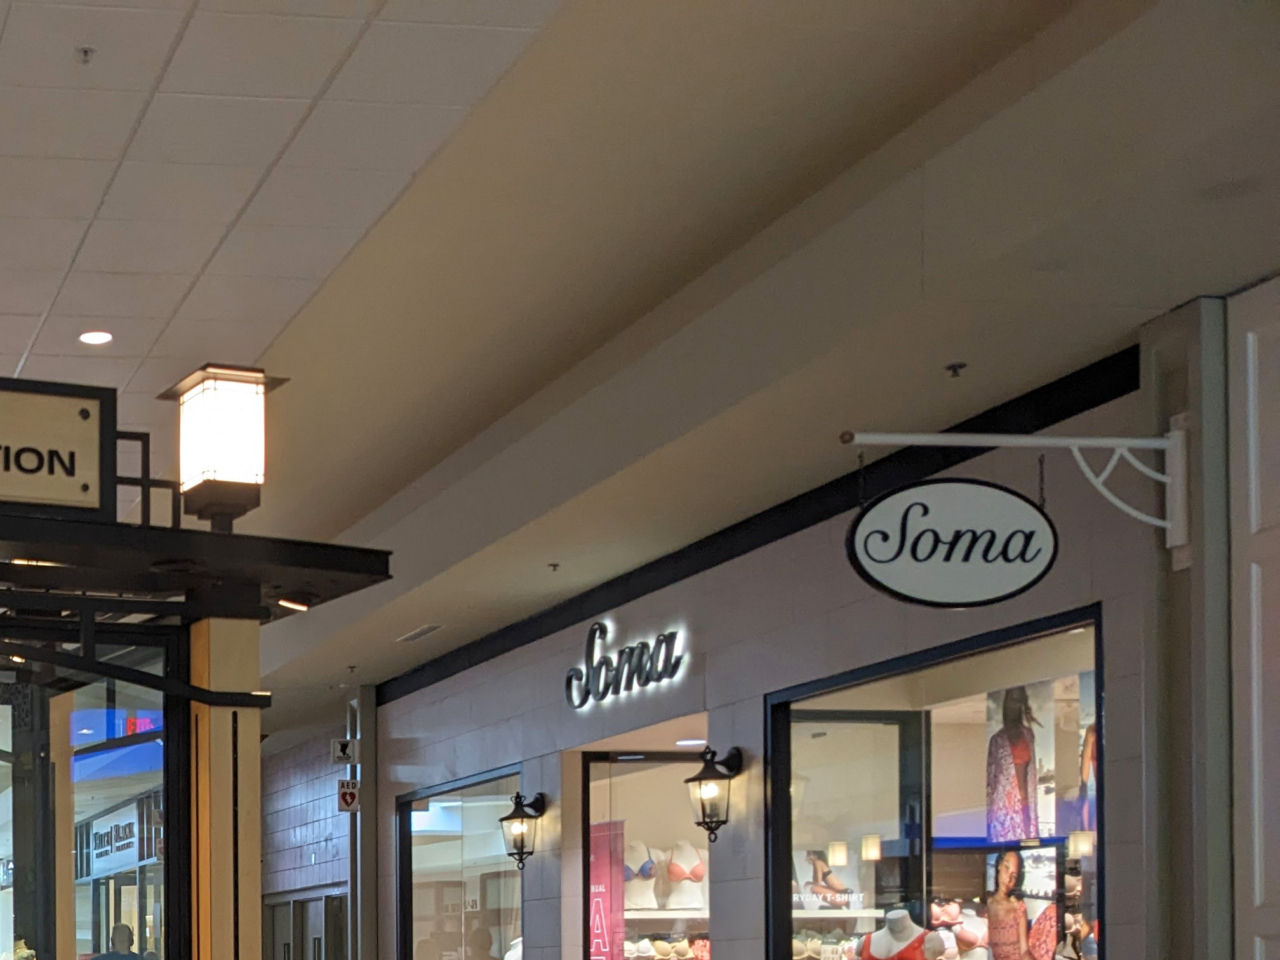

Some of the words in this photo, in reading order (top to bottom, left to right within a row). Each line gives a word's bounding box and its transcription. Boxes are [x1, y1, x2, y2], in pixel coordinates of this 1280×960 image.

[863, 502, 1043, 564] Soma
[564, 621, 685, 711] Soma
[340, 782, 357, 790] AED
[590, 884, 606, 892] NUAL
[793, 893, 824, 902] RYDAY
[826, 893, 865, 902] T-SHIRT
